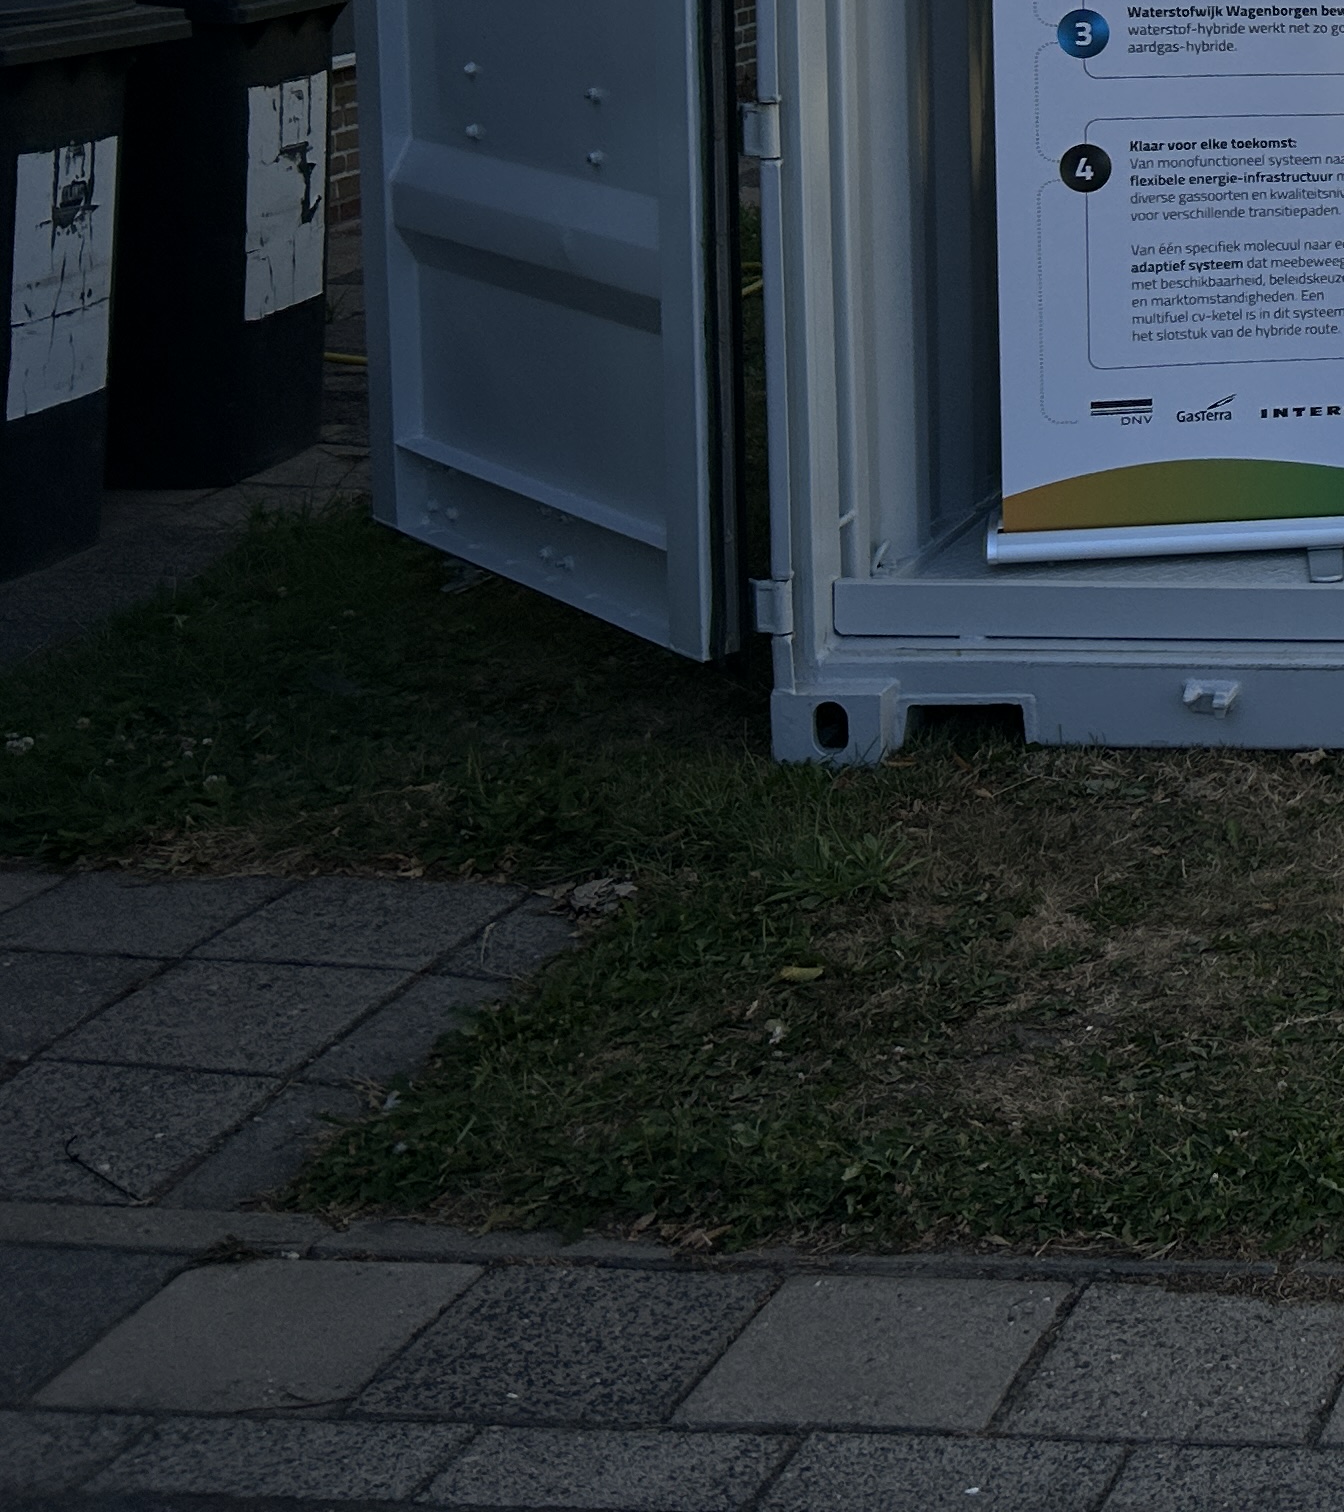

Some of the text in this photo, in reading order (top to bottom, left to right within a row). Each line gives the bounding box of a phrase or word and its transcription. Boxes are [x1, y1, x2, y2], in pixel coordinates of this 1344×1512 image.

[1127, 6, 1223, 19] Waterstofwijk
[1226, 5, 1317, 20] Wagenborgen
[1075, 22, 1092, 46] 3
[1128, 22, 1246, 38] waterstof-hybride
[1248, 21, 1286, 34] werkt
[1289, 22, 1310, 34] net
[1313, 23, 1328, 34] zo
[1128, 40, 1238, 55] aardgas-hybride.
[1129, 138, 1298, 152] Klaar voor elke toekomst:
[1075, 157, 1094, 181] 4
[1130, 158, 1155, 169] Van
[1158, 155, 1265, 169] monofunctioneel
[1268, 155, 1322, 169] systeem
[1130, 173, 1185, 187] flexibele
[1189, 171, 1333, 187] energie-infrastructuur
[1130, 191, 1175, 205] diverse
[1178, 191, 1249, 206] gassoorten
[1251, 191, 1267, 201] en
[1131, 205, 1341, 222] voor verschillende transitiepaden.
[1131, 244, 1155, 256] Van
[1158, 242, 1182, 255] één
[1185, 240, 1240, 256] specifiek
[1244, 239, 1300, 253] molecuul
[1303, 240, 1331, 251] naar
[1131, 259, 1185, 275] adaptief
[1188, 259, 1243, 273] systeem
[1246, 257, 1267, 269] dat
[1131, 279, 1157, 290] met
[1160, 274, 1266, 289] beschikbaarheid,
[1131, 298, 1148, 308] en
[1301, 290, 1324, 302] Een
[1132, 311, 1188, 324] multifuel
[1191, 308, 1243, 322] cv-ketel
[1245, 310, 1256, 321] is
[1259, 309, 1270, 320] in
[1273, 307, 1290, 320] dit
[1132, 329, 1154, 342] het
[1156, 326, 1208, 340] slotstuk
[1211, 328, 1233, 338] van
[1237, 325, 1253, 338] de
[1255, 324, 1301, 339] hybride
[1120, 415, 1153, 426] DNV
[1176, 409, 1232, 423] GasTerra
